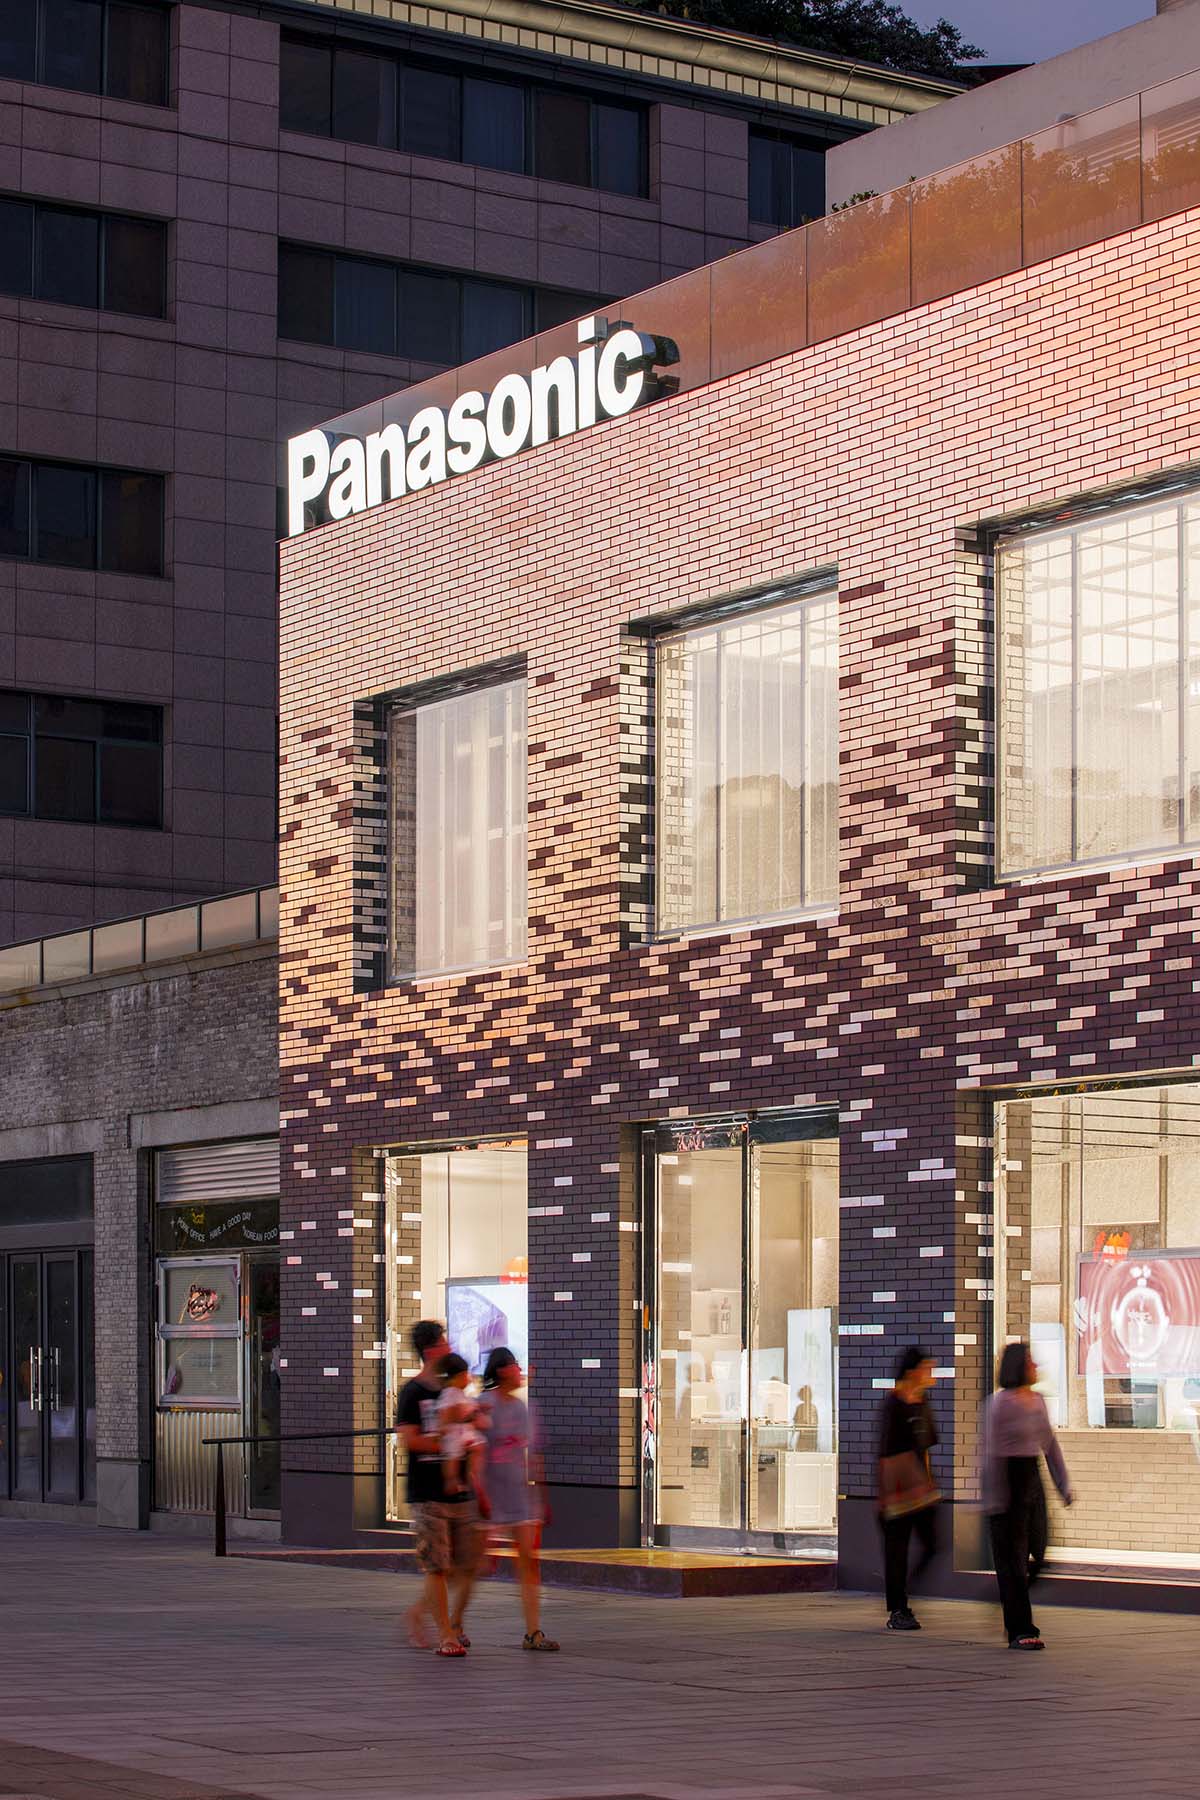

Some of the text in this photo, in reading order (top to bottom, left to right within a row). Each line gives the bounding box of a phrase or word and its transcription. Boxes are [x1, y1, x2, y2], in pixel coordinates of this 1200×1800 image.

[288, 316, 645, 537] Panasonic
[189, 1229, 206, 1243] OFFICE
[209, 1226, 222, 1240] HAVE
[222, 1223, 227, 1233] A
[227, 1214, 242, 1228] GOOD
[242, 1212, 252, 1222] DAY
[243, 1227, 279, 1242] KOREAN FOOD
